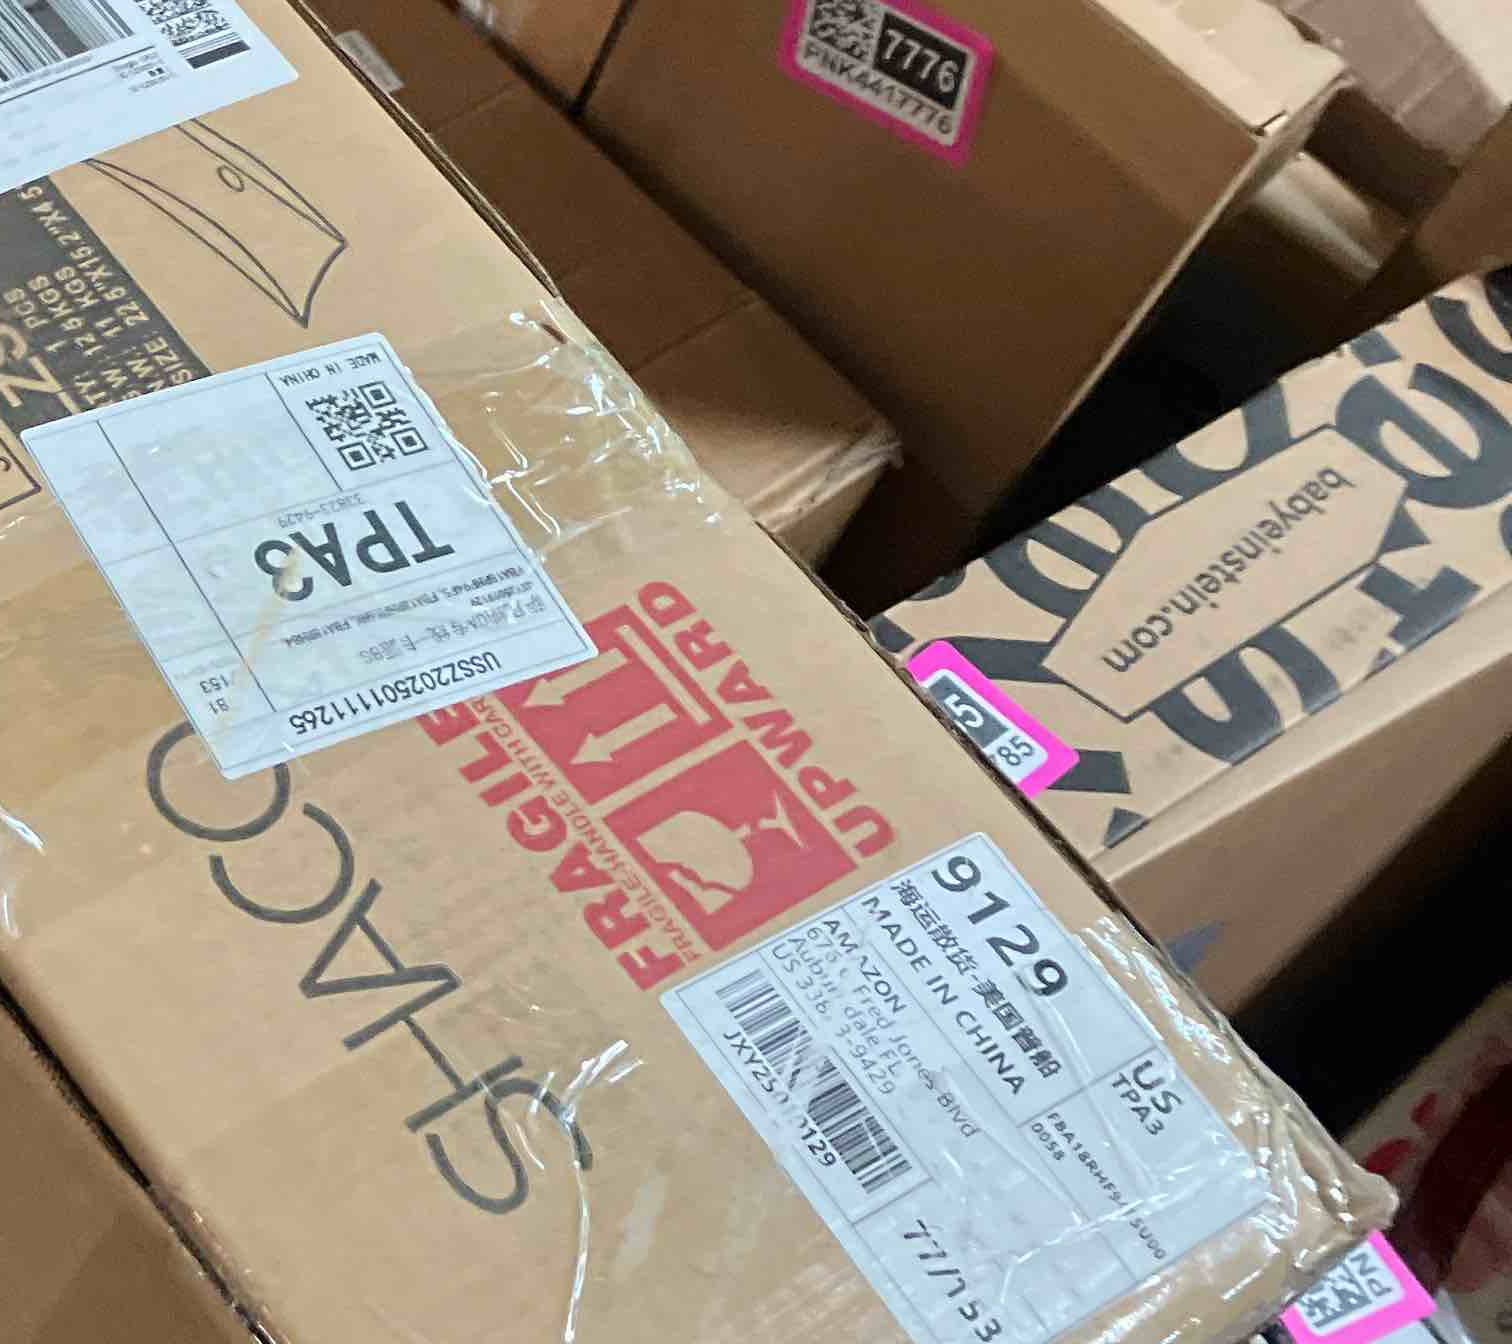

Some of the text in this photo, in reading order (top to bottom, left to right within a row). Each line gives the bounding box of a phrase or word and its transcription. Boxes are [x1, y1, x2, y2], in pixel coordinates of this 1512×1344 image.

[872, 26, 965, 96] 7776
[51, 263, 100, 309] KGS
[70, 369, 112, 408] TY:
[277, 366, 322, 387] CHINA
[322, 361, 343, 375] IN
[244, 494, 456, 608] TPA3
[1105, 466, 1357, 675] babyeinstein.com
[285, 649, 503, 736] USSZ202501111265
[467, 693, 519, 745] CAR
[629, 568, 901, 865] UPWARD
[413, 692, 686, 993] FRAGILE
[768, 941, 803, 974] US
[926, 848, 1076, 1006] 9129
[859, 893, 1032, 1097] MADE IN CHINA
[849, 982, 897, 1032] Fred
[886, 1030, 942, 1092] Jones
[933, 1090, 980, 1140] Blvd
[1124, 1057, 1187, 1119] US
[1105, 1071, 1168, 1139] TPA3
